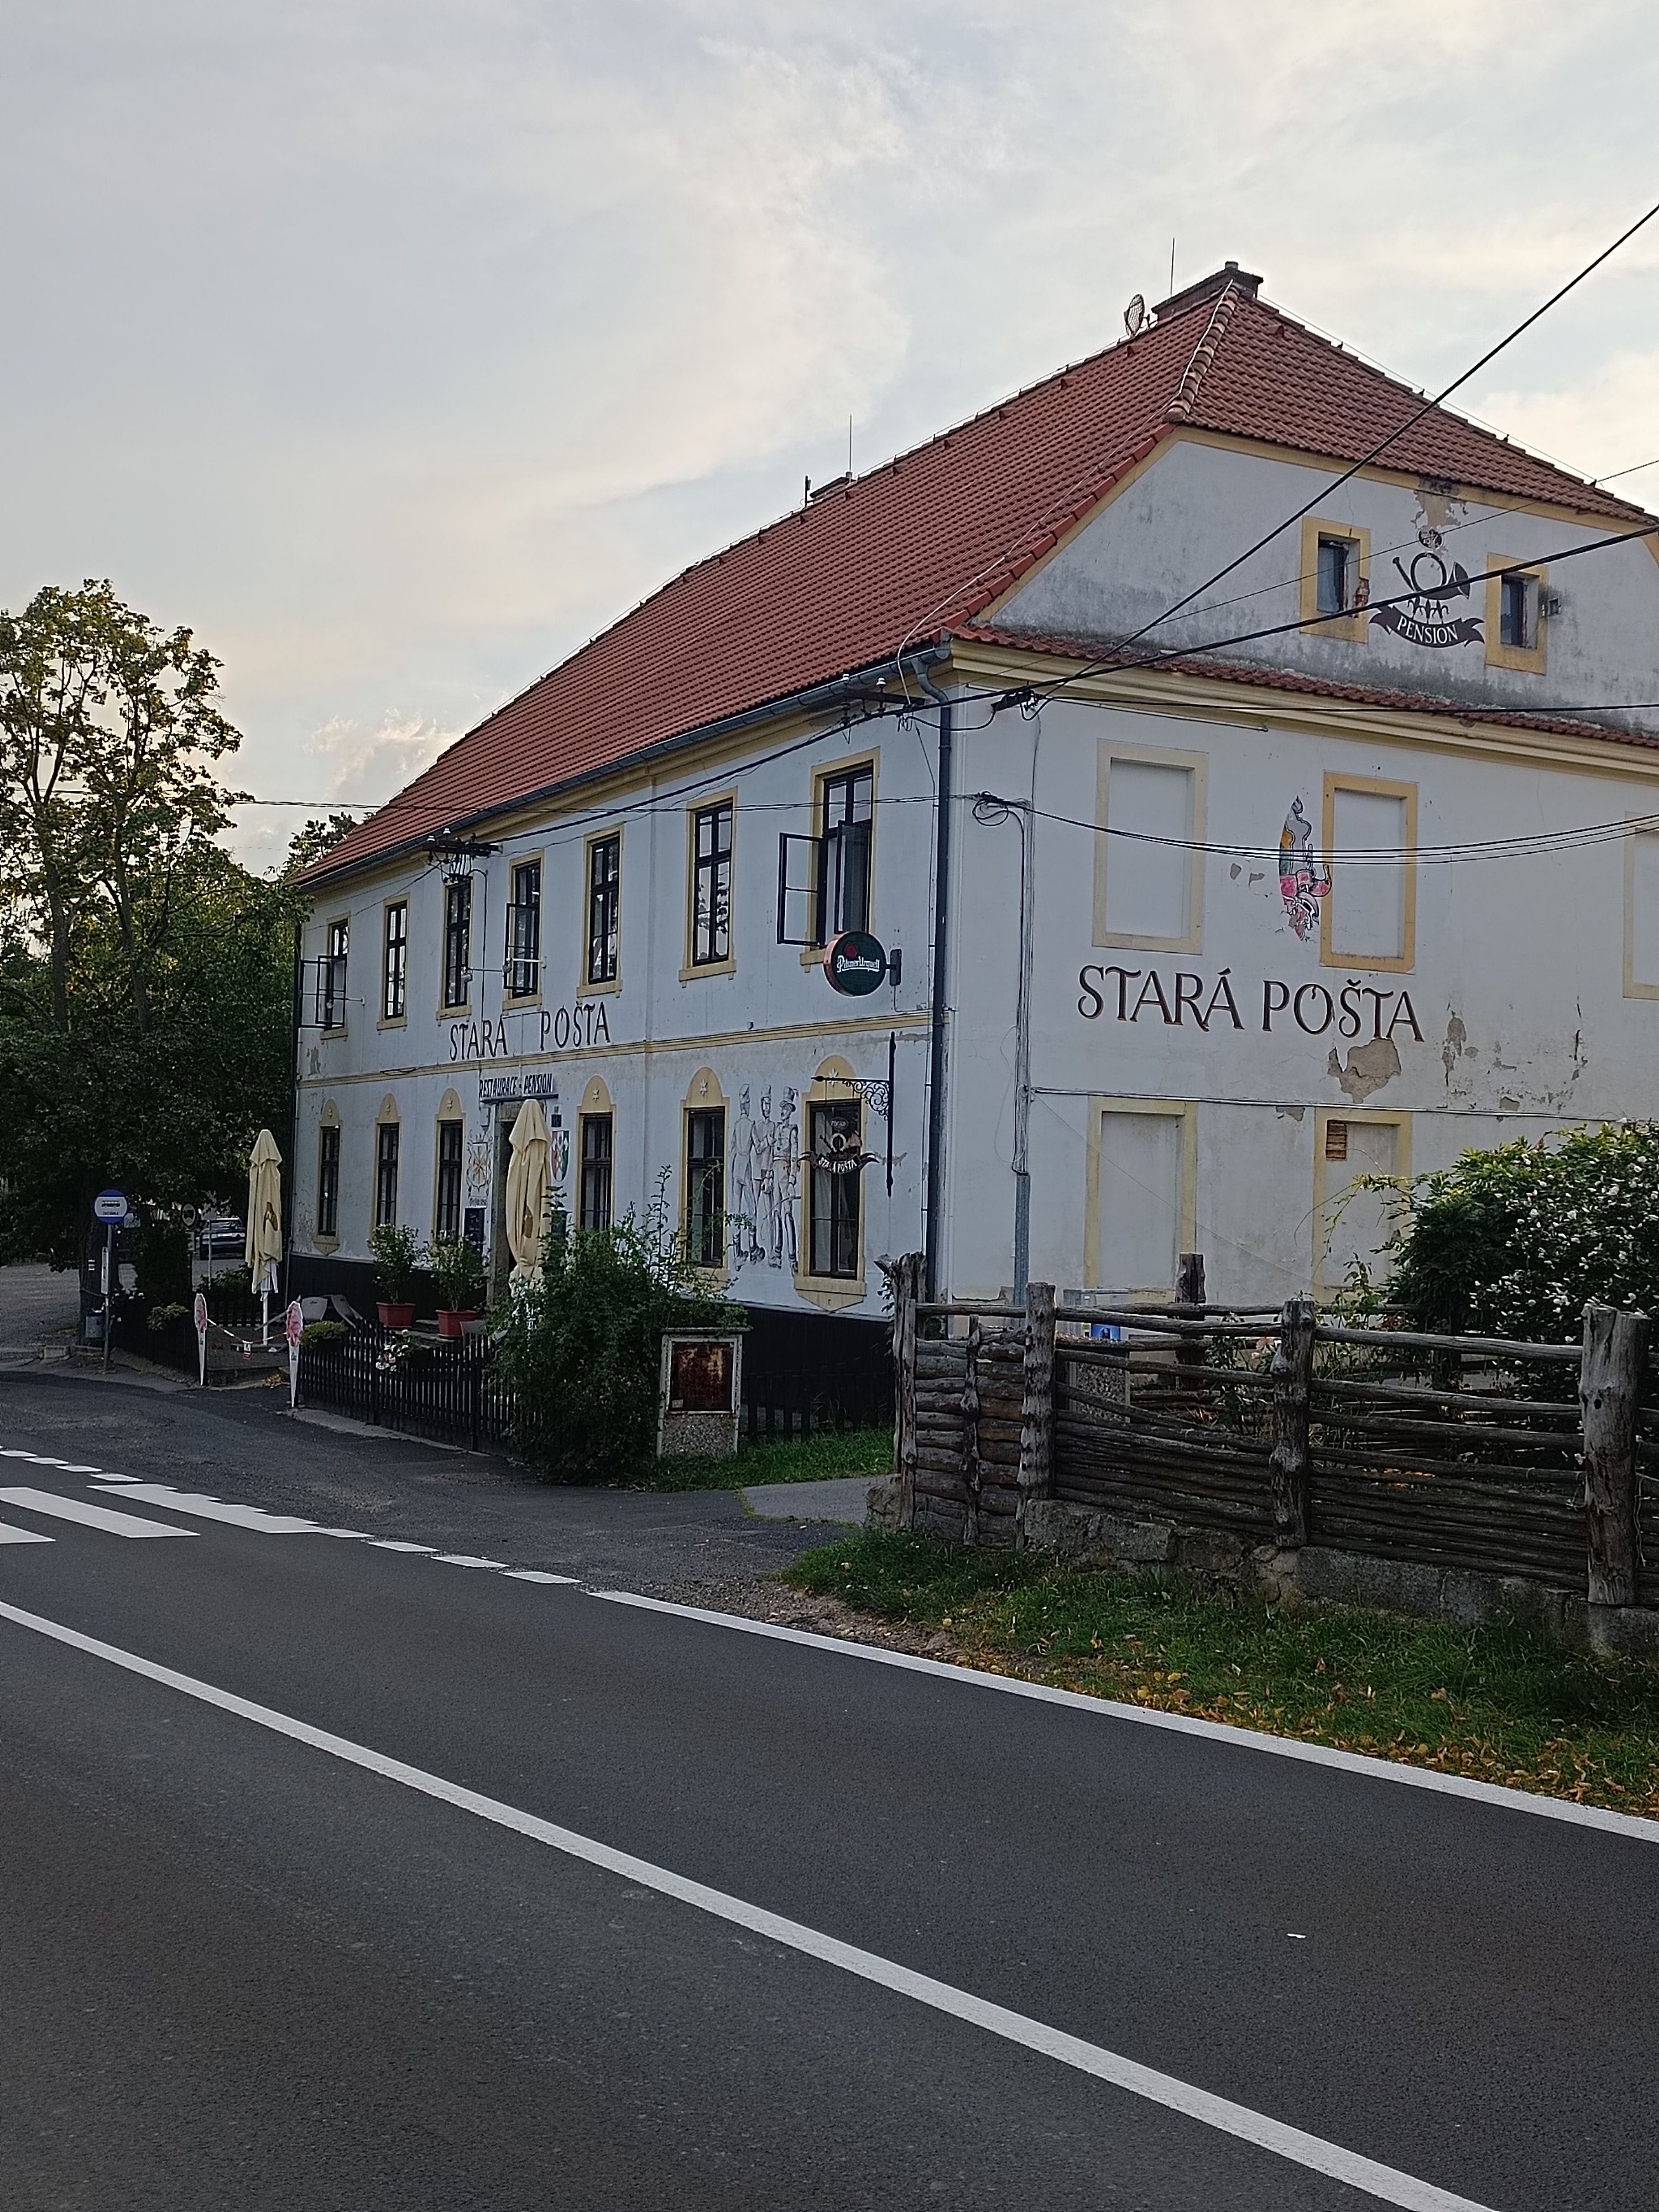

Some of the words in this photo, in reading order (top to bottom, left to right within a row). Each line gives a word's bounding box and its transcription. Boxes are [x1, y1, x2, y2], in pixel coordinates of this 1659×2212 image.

[1397, 615, 1458, 644] PENSION
[1078, 965, 1245, 1032] STARÁ
[1262, 979, 1425, 1042] POŠTA
[540, 1001, 611, 1051] POŠTA
[479, 1076, 518, 1098] RESTAURACE
[523, 1073, 552, 1094] PENSION
